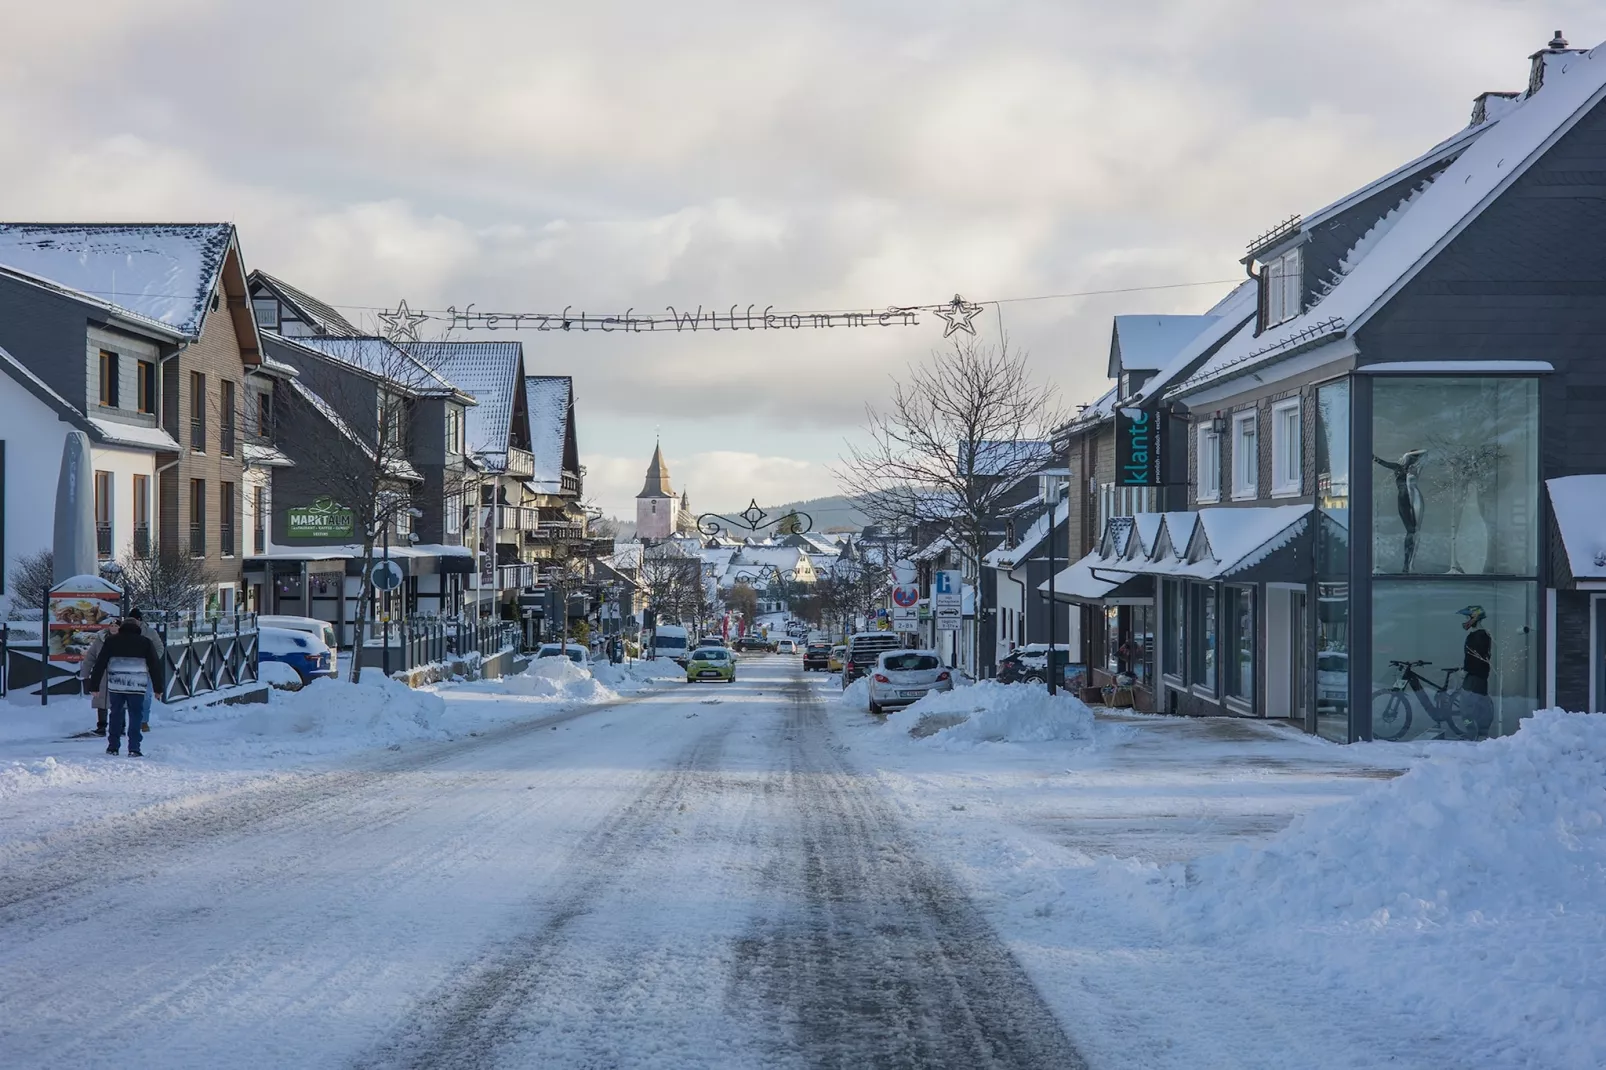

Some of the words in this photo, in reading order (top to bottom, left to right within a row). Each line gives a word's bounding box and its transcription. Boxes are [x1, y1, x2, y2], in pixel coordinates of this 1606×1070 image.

[447, 303, 650, 332] Herzlich
[666, 304, 919, 332] Willkommen
[1124, 412, 1149, 484] klante
[291, 515, 350, 525] MARKTALM
